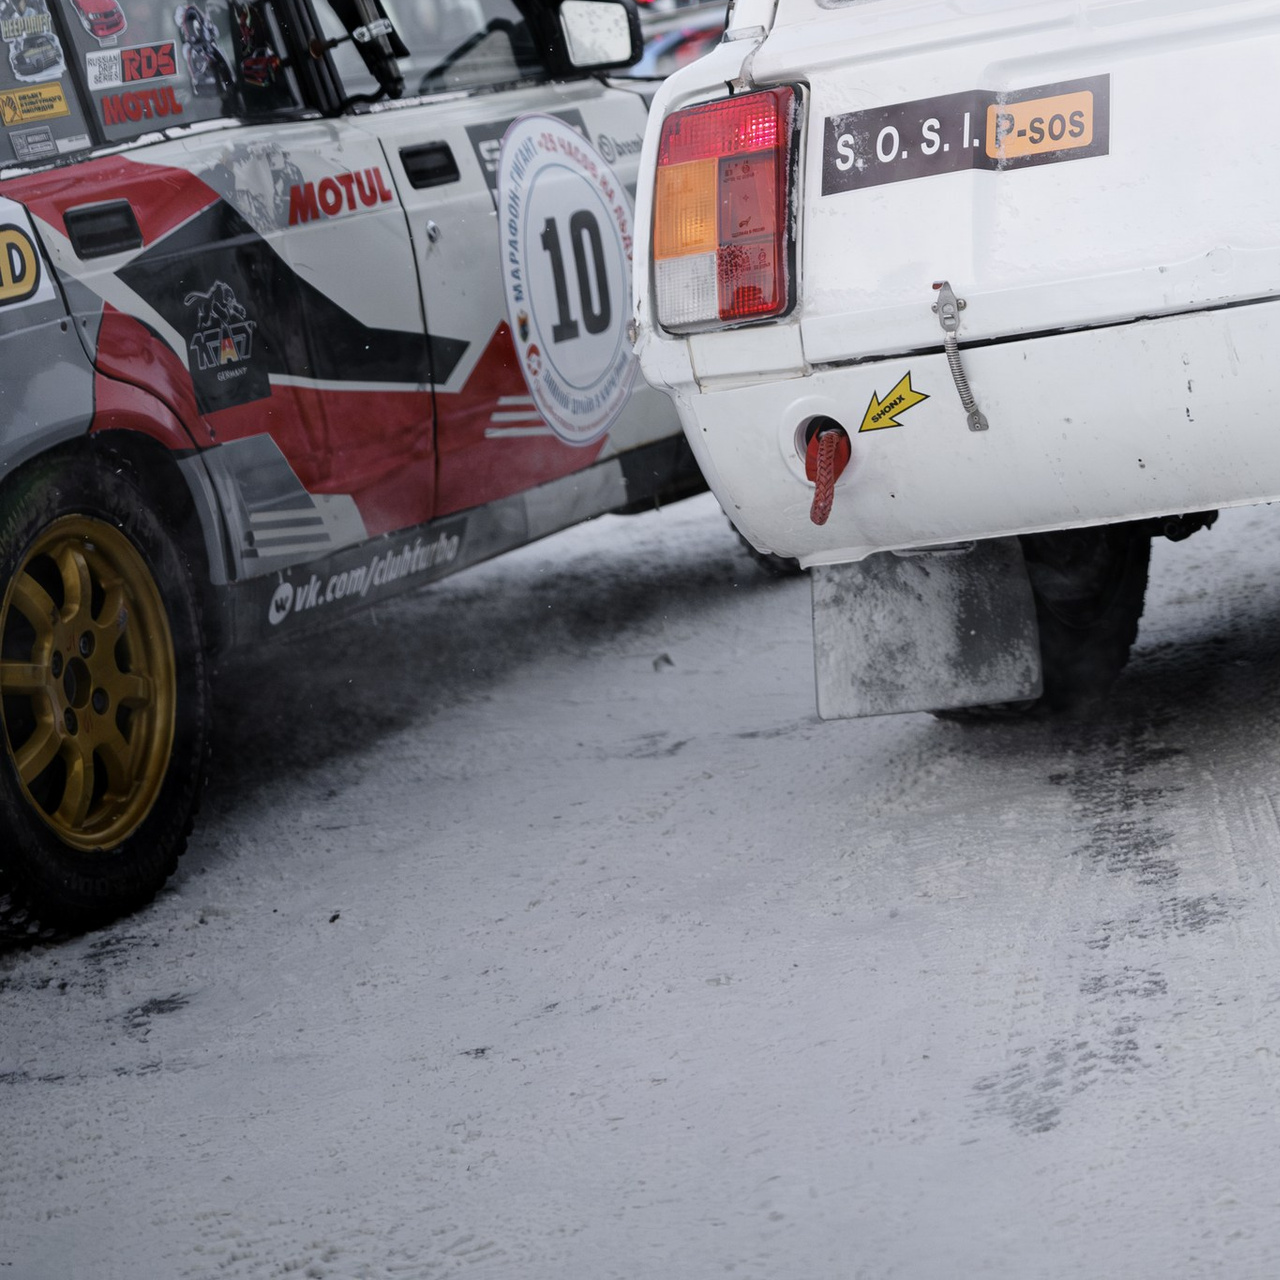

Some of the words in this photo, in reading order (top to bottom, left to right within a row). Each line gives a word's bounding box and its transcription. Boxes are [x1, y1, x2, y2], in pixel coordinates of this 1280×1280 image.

[121, 43, 175, 82] RDS
[101, 85, 183, 126] MOTUL
[287, 166, 393, 227] MOTUL
[540, 209, 612, 343] 10
[871, 394, 905, 423] SHONX
